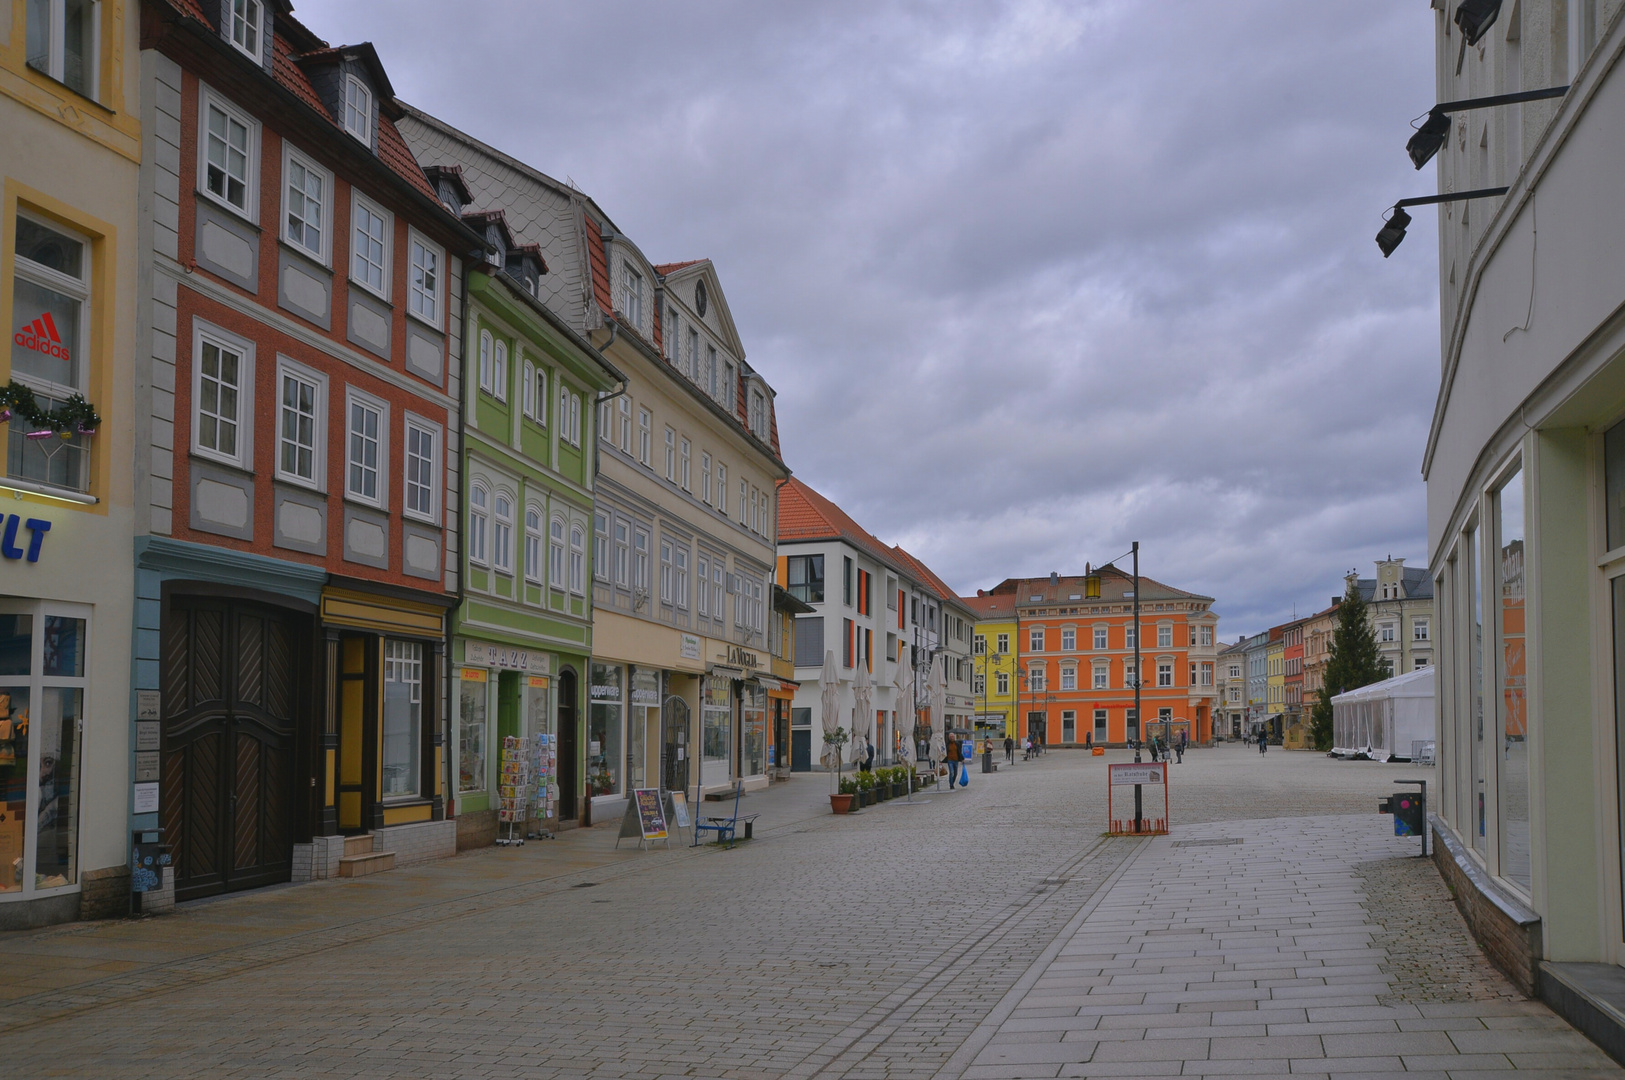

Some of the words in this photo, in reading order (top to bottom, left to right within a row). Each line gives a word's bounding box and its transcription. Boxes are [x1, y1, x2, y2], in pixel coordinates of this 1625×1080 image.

[14, 333, 70, 361] adidas
[0, 513, 52, 563] LT
[488, 647, 528, 669] TAZZ
[727, 645, 736, 664] LA
[591, 685, 619, 698] upperware
[632, 688, 657, 700] upperware
